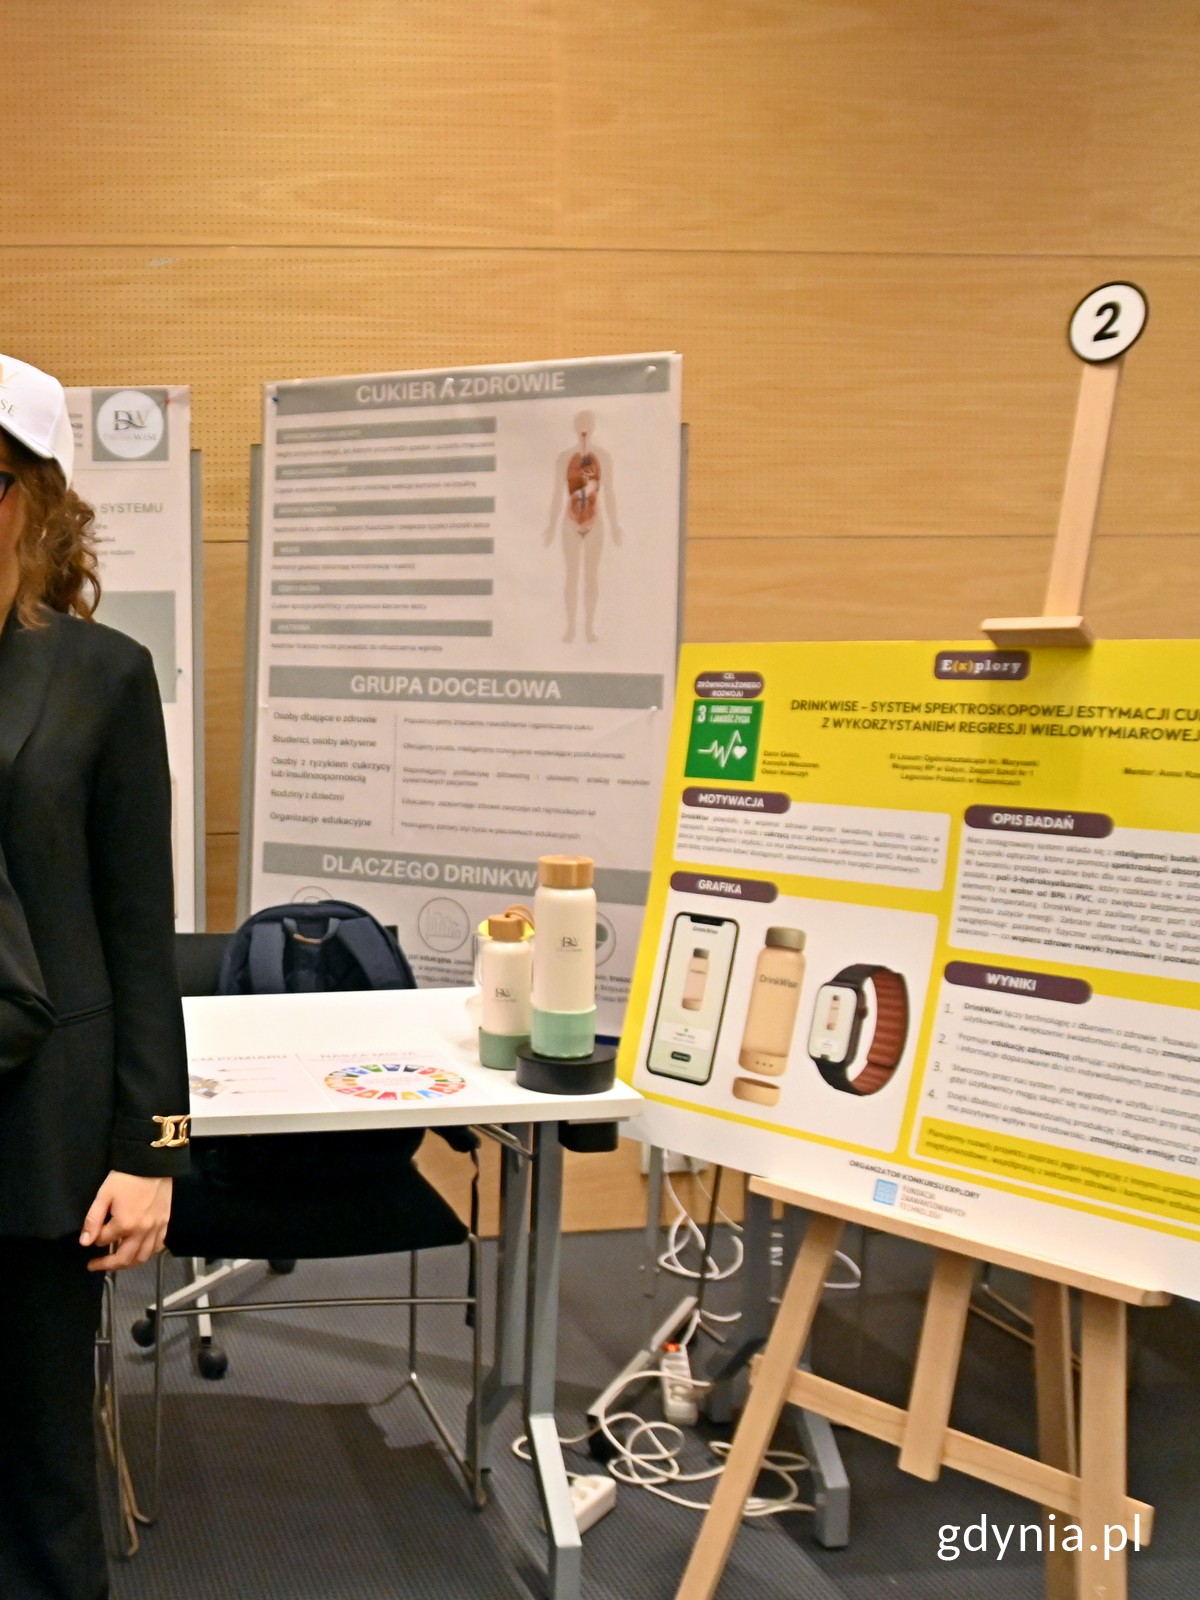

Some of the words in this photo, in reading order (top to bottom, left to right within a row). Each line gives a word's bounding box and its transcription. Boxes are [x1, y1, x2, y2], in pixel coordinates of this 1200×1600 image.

[1092, 301, 1121, 341] 2
[355, 381, 436, 403] CUKIER
[440, 380, 455, 399] A
[460, 372, 566, 397] ZDROWIE
[101, 503, 163, 513] SYSTEMU
[351, 675, 424, 696] GRUPA
[428, 677, 562, 699] DOCELOWA
[273, 712, 298, 722] Osoby
[343, 715, 377, 723] zdrowie
[697, 704, 707, 723] 3
[791, 700, 859, 712] DRINKWISE
[871, 701, 921, 714] SYSTEM
[924, 702, 1074, 718] SPEKTROSKOPOWEJ
[1077, 705, 1171, 721] ESTYMACJI
[1174, 708, 1200, 721] CU
[821, 718, 831, 729] Z
[833, 718, 956, 733] WYKORZYSTANIEM
[959, 721, 1027, 736] REGRESJI
[1031, 724, 1200, 742] WIELOWYMIAROWEJ
[312, 737, 338, 746] osoby
[340, 738, 376, 747] aktywne
[272, 757, 297, 766] Osoby
[309, 759, 348, 768] ryzykiem
[352, 761, 391, 771] cukrzycy
[271, 789, 304, 799] Rodziny
[699, 793, 765, 808] MOTYWACJA
[270, 812, 319, 823] Organizacje
[322, 816, 373, 827] edukacyjne
[992, 813, 1024, 826] OPIS
[1025, 814, 1074, 830] BADAŃ
[322, 854, 439, 881] DLACZEGO
[444, 864, 538, 889] DRINKW
[698, 879, 742, 895] GRAFIKA
[760, 974, 799, 989] DrinkWise
[985, 972, 1036, 991] WYNIKI
[964, 1001, 1003, 1015] DrinkWise
[848, 1159, 903, 1179] ORGANIZATOR
[902, 1174, 945, 1190] KONKURSU
[944, 1184, 982, 1200] EXPLORY
